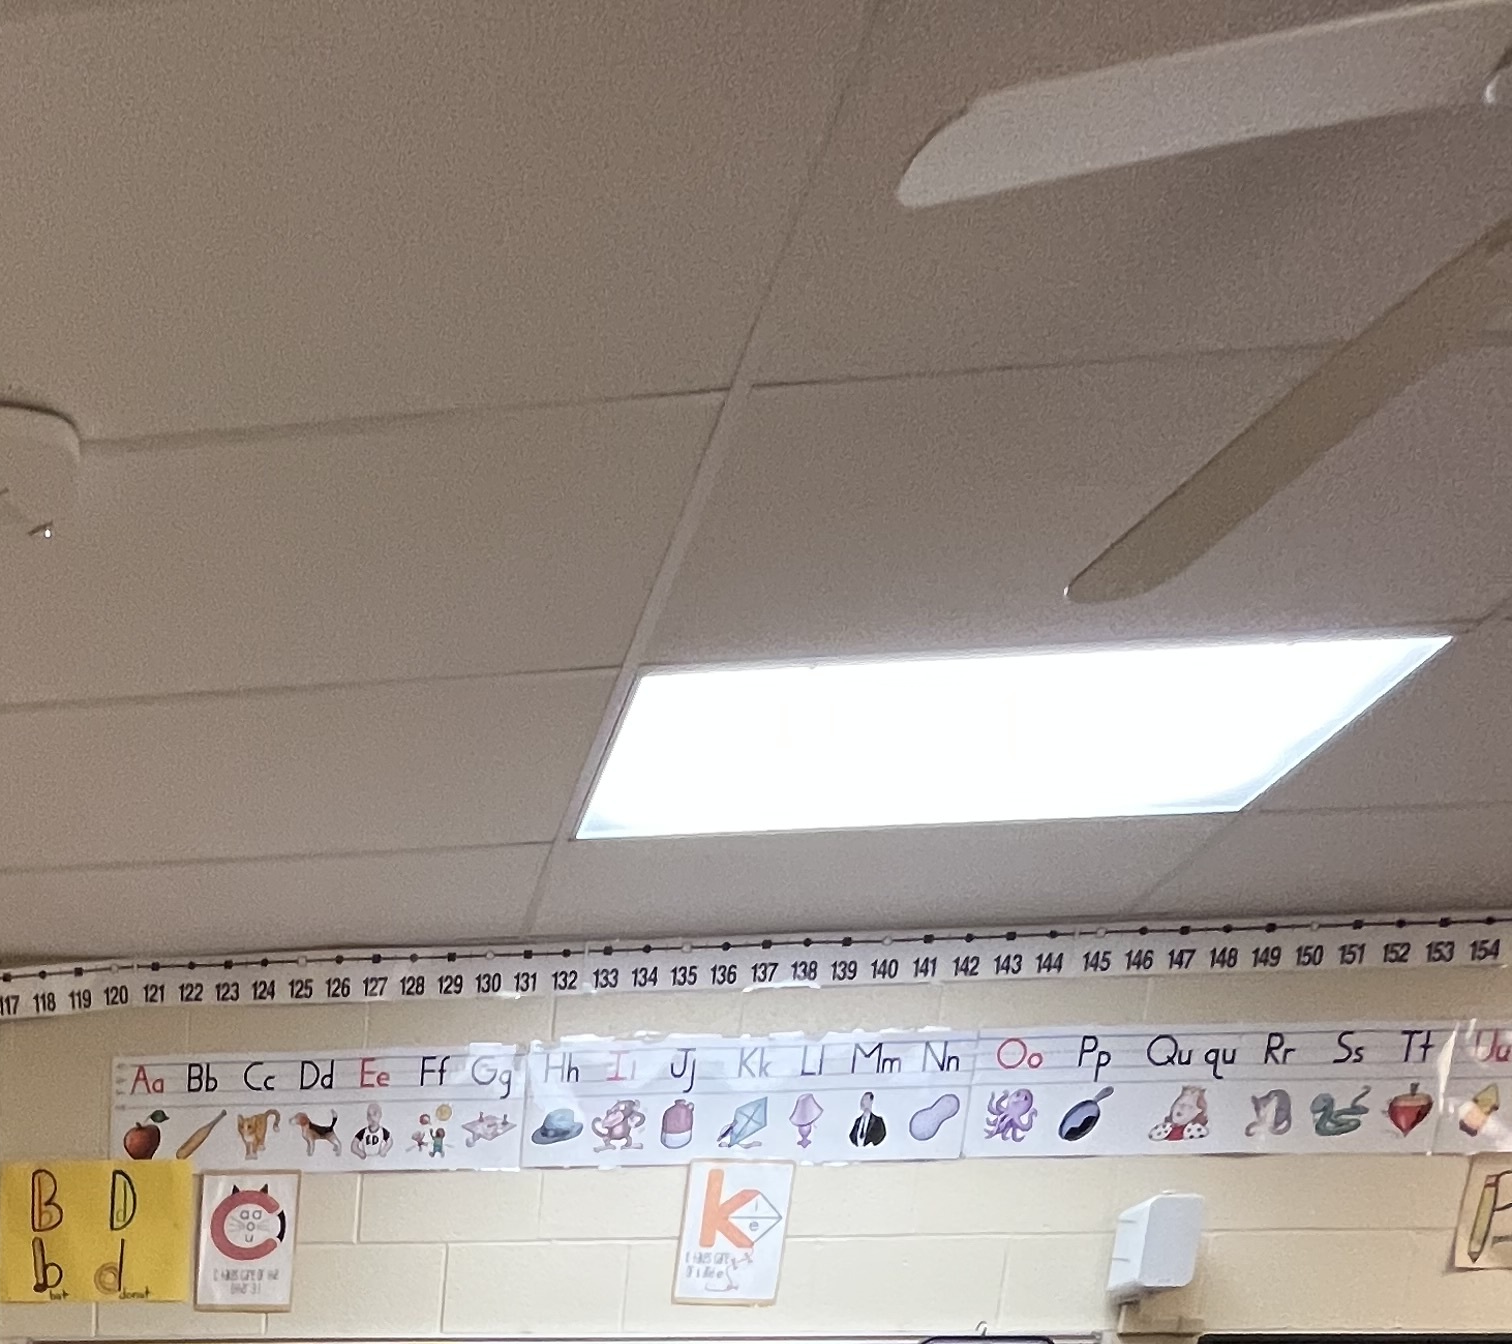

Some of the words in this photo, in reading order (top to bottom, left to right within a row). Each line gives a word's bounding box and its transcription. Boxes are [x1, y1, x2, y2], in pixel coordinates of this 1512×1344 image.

[179, 983, 203, 1001] 122
[552, 971, 578, 990] 132
[872, 960, 898, 979] 140
[1470, 940, 1499, 960] 154
[131, 1065, 164, 1094] Aa
[188, 1064, 217, 1092] Bb
[244, 1062, 275, 1091] Cc
[300, 1061, 334, 1089] Dd
[360, 1058, 389, 1087] Ee
[420, 1056, 450, 1086] Ff
[671, 1048, 696, 1092] Jj
[852, 1043, 901, 1073] Mm
[922, 1041, 959, 1072] Nn
[997, 1038, 1042, 1068] Oo
[1078, 1036, 1110, 1081] Pp
[1147, 1035, 1192, 1066] Qu
[1205, 1047, 1236, 1078] qu
[1264, 1034, 1295, 1064] Rr
[1334, 1032, 1364, 1063] Ss
[1402, 1030, 1434, 1060] Tt
